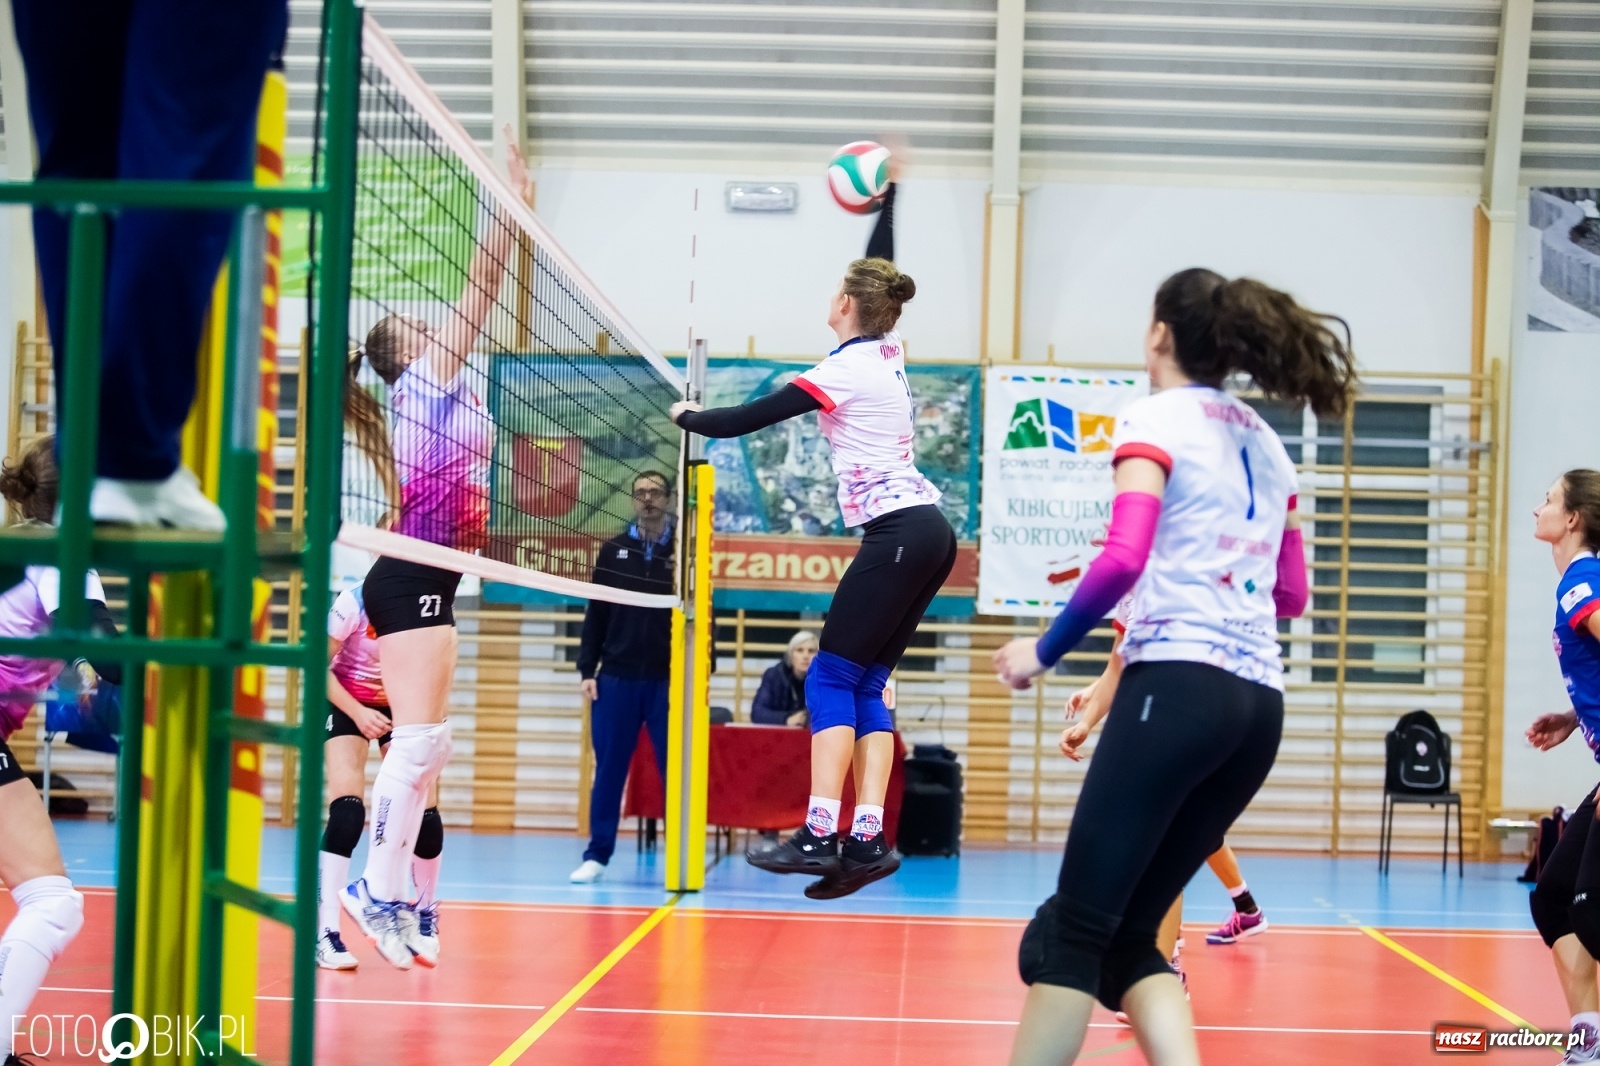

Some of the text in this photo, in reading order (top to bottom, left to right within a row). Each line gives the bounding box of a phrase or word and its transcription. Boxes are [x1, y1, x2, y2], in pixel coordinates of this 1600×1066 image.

[1240, 446, 1256, 520] 1
[1007, 499, 1111, 523] KIBICUJEM
[516, 538, 853, 581] Gmi rzano
[418, 594, 442, 618] 27
